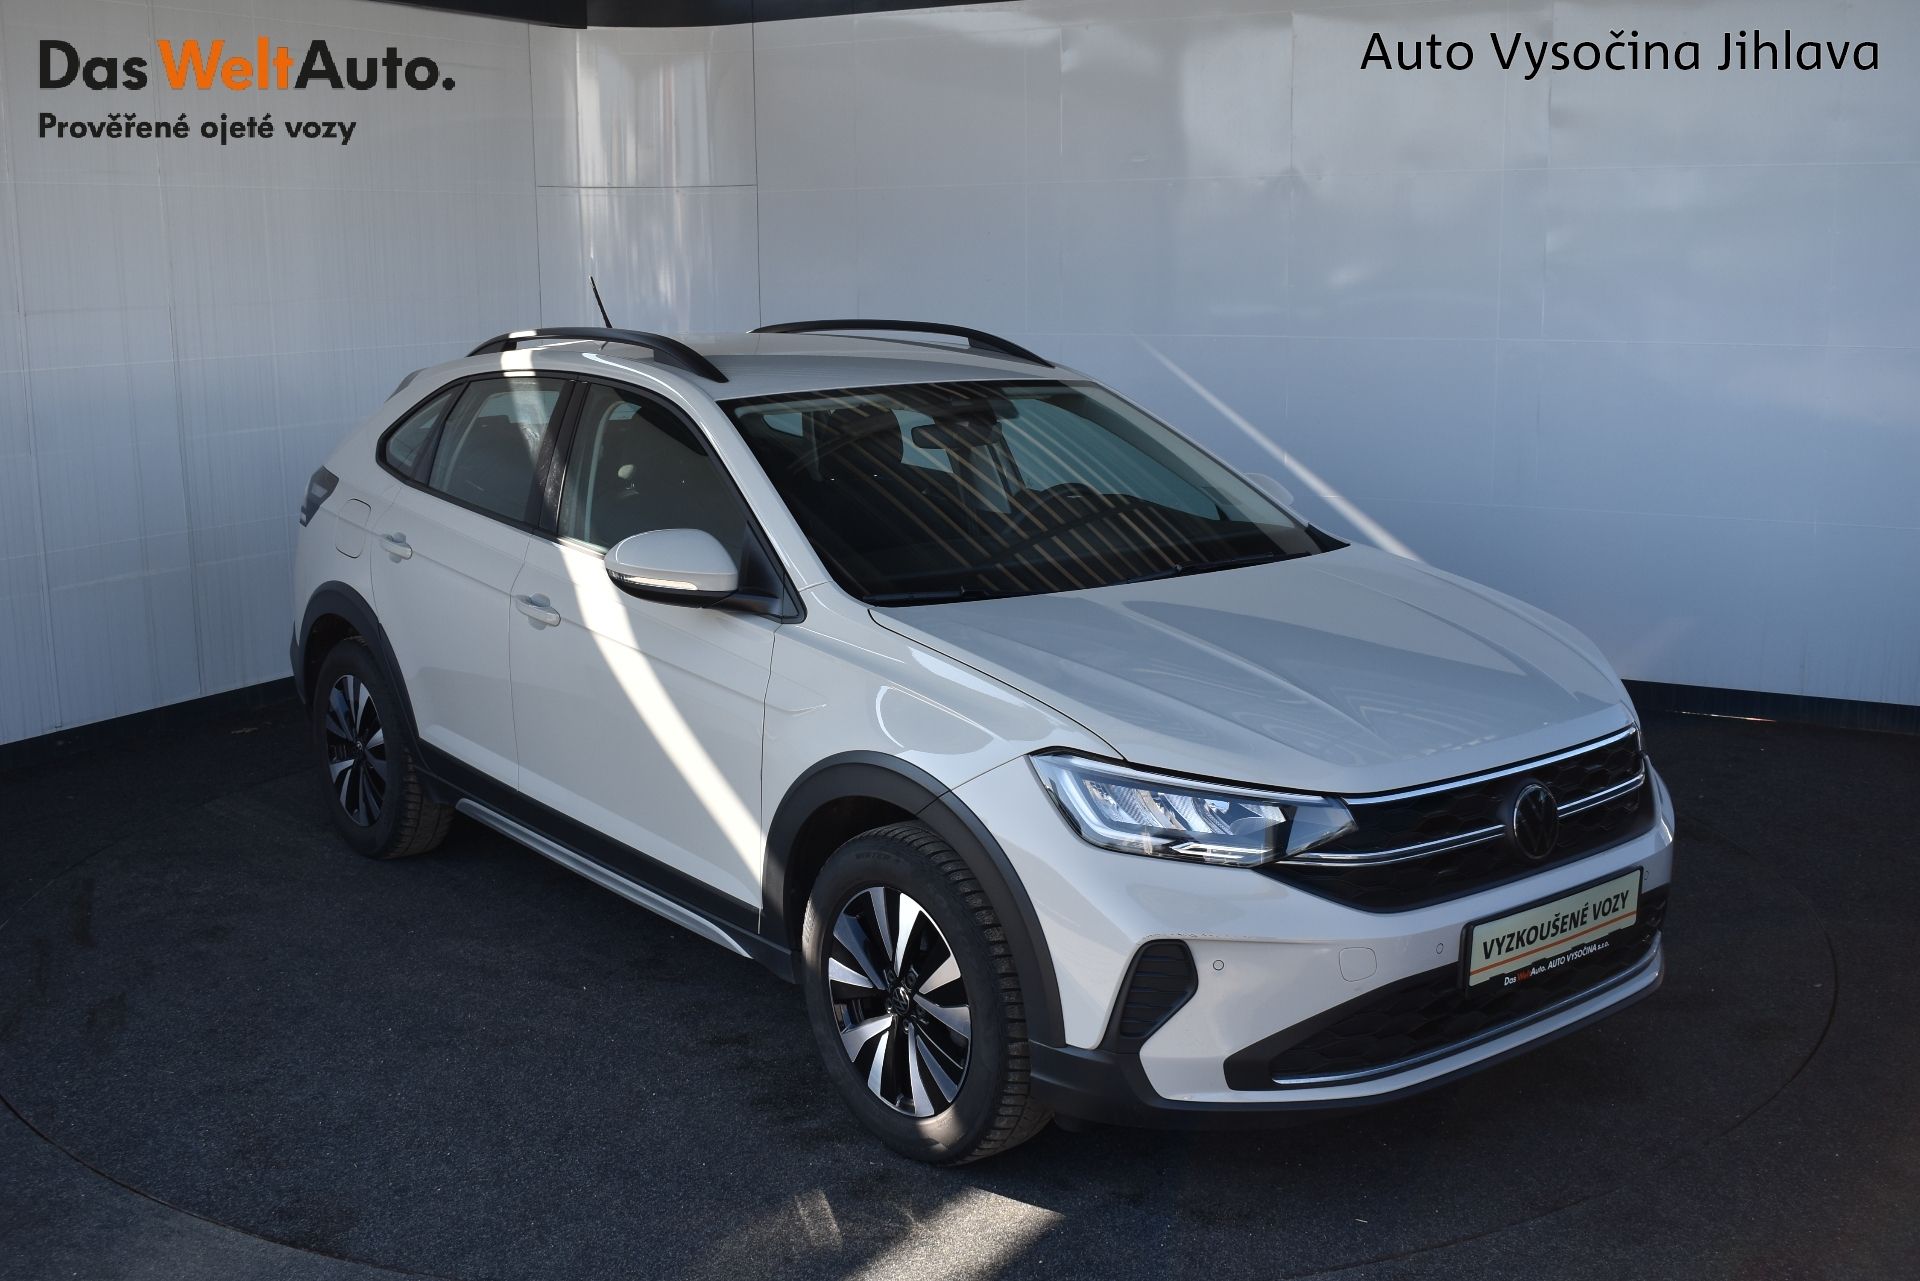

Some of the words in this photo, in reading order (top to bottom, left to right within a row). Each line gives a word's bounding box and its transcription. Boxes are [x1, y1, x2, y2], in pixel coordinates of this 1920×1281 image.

[1482, 902, 1589, 960] VYZKOUŠENÉ
[1592, 890, 1630, 920] VOZY
[1503, 975, 1517, 986] Das
[1547, 956, 1566, 970] AUTO
[1566, 944, 1597, 963] VYSOČINA
